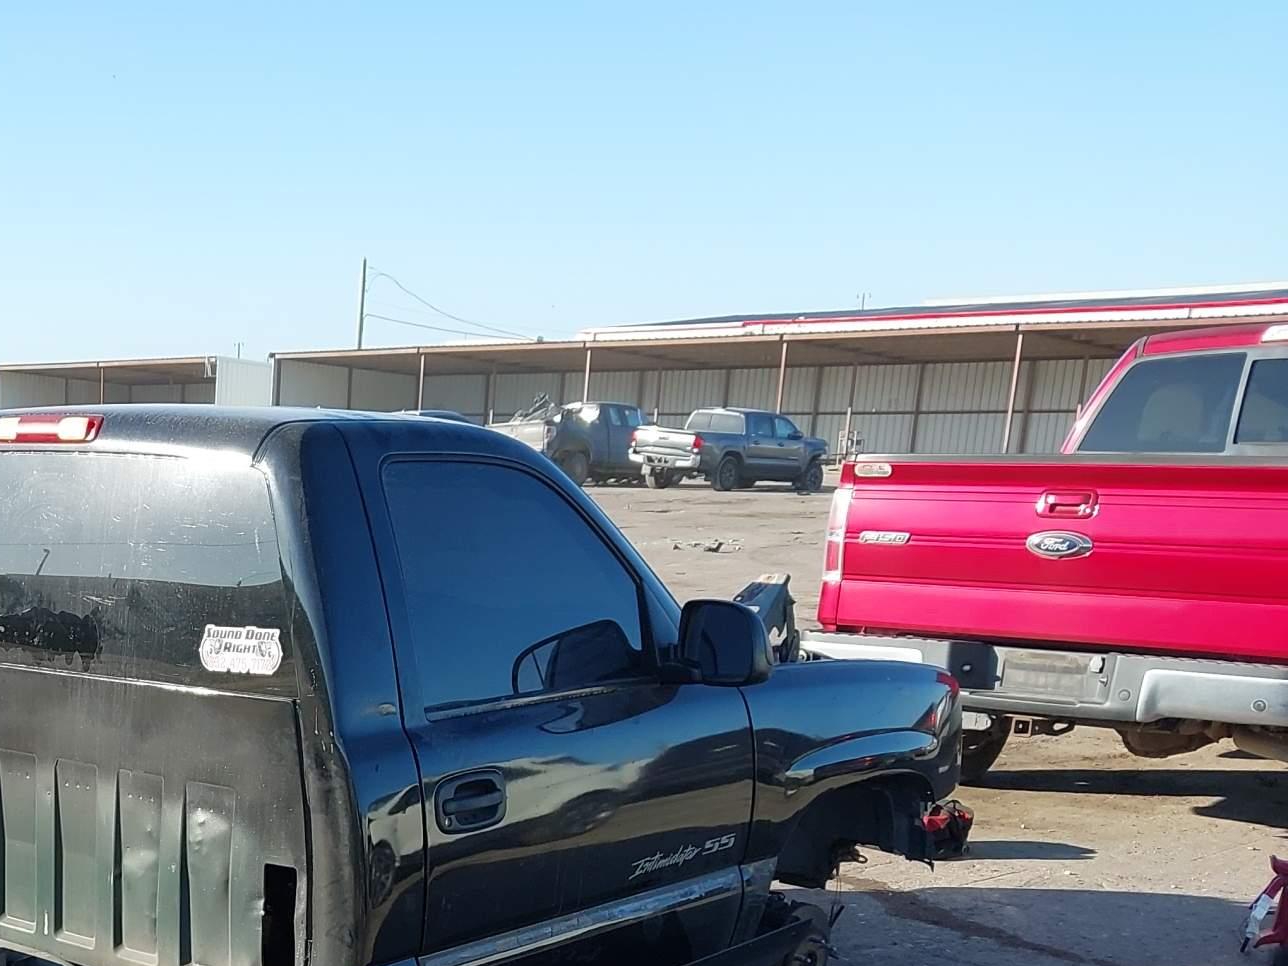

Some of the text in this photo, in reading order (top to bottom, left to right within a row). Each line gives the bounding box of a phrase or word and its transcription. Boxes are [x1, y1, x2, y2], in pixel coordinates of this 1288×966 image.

[1040, 537, 1070, 551] Ford
[223, 642, 258, 654] RIGHT
[628, 833, 736, 880] Intimidator SS
